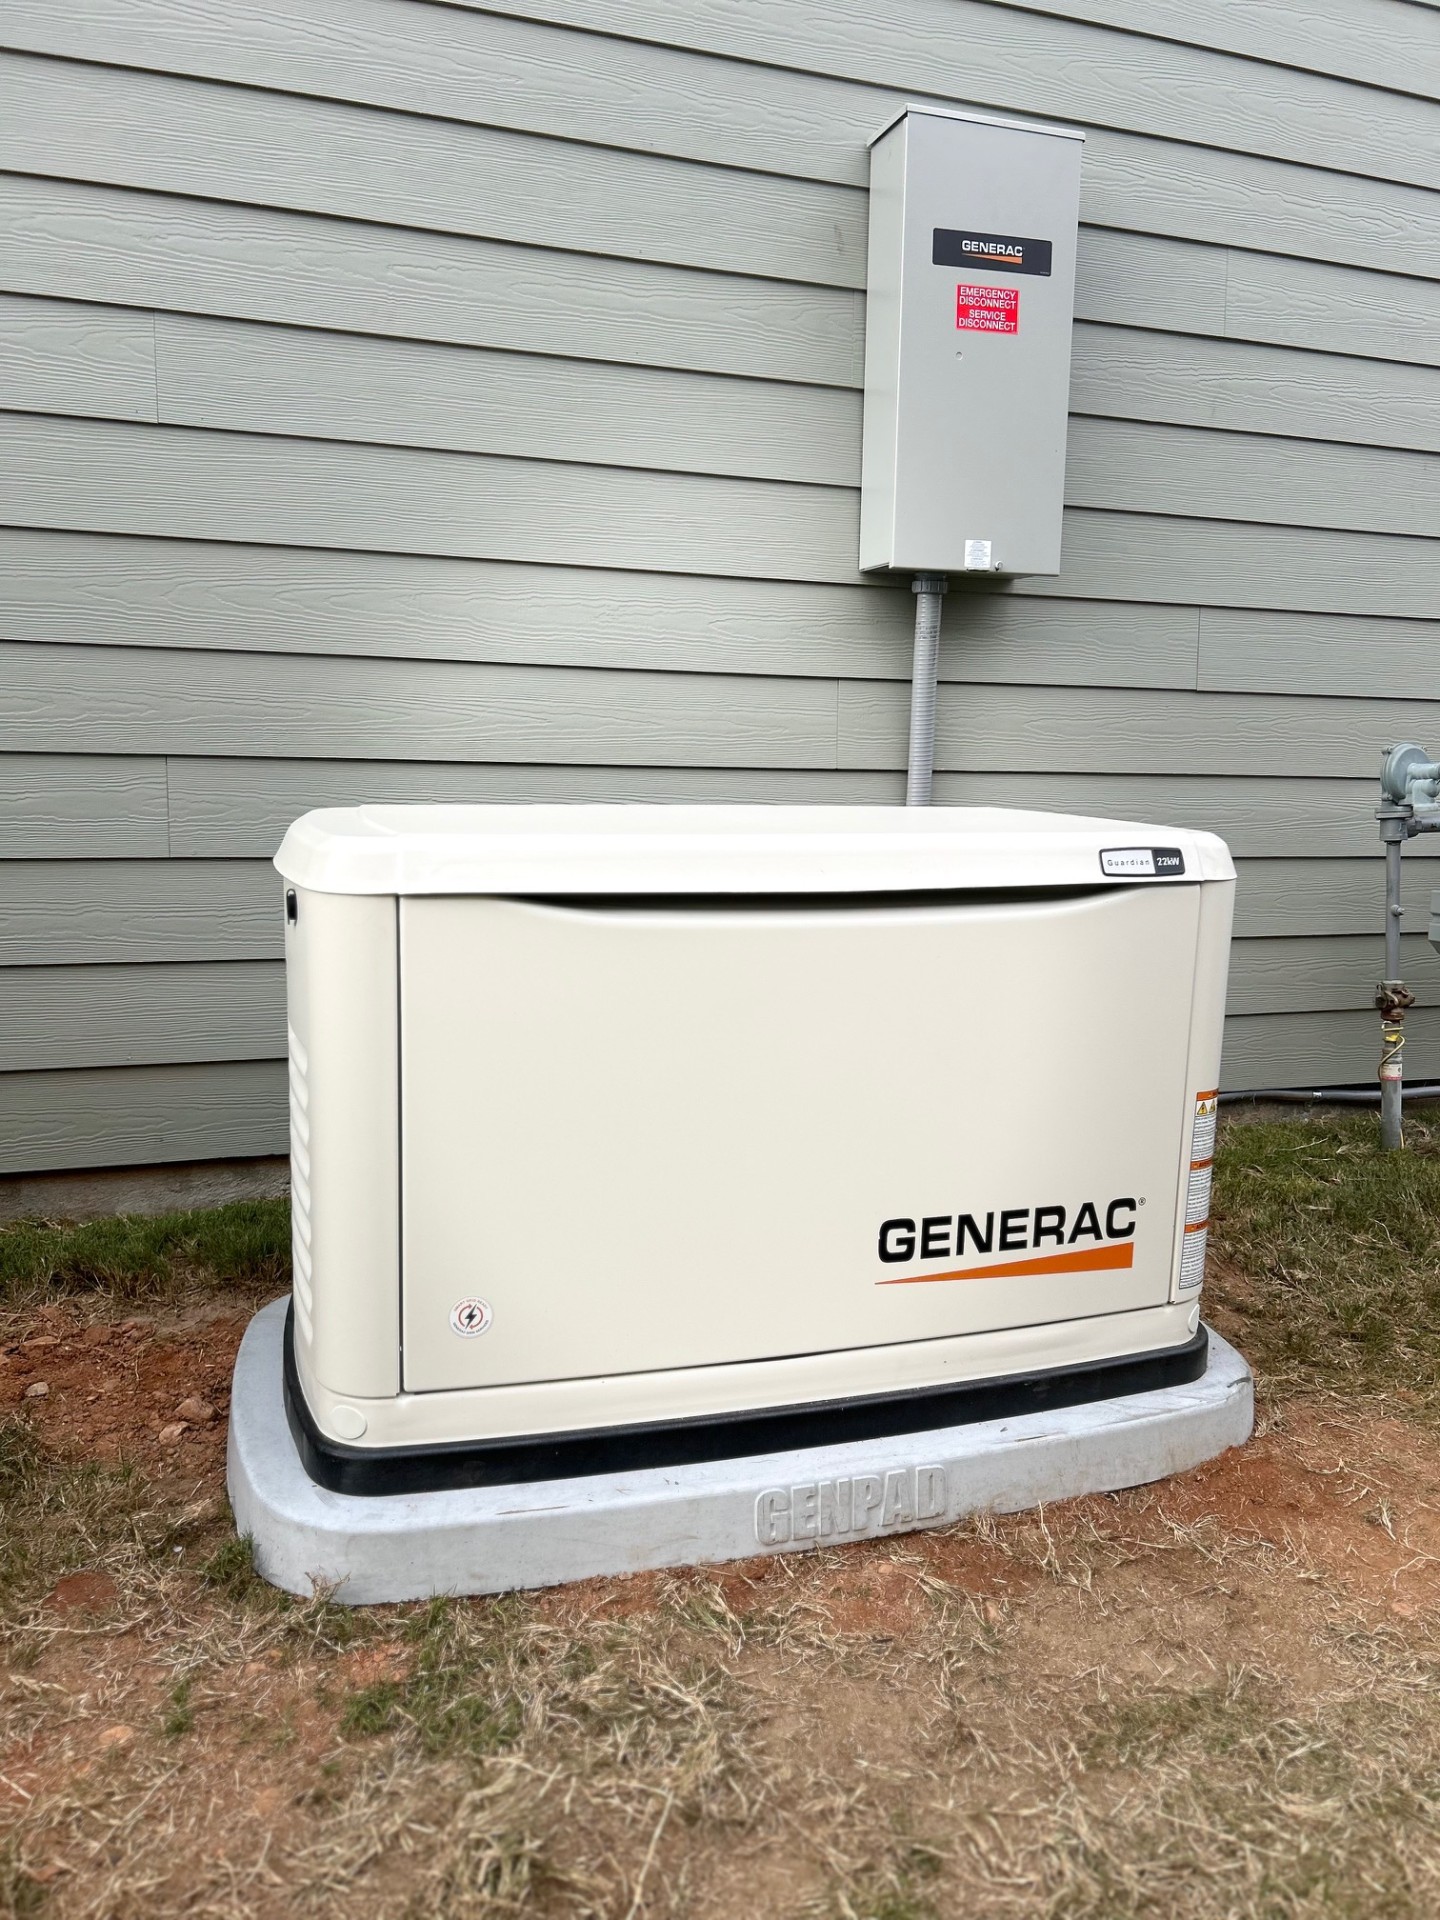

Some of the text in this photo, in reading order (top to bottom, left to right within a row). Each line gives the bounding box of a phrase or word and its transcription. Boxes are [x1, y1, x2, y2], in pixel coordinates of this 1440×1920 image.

[962, 240, 1023, 256] GENERAC
[960, 287, 1016, 300] EMERGENCY
[959, 296, 1016, 310] DISCONNECT
[969, 309, 1006, 321] SERVICE
[958, 318, 1016, 331] DISCONNECT
[1107, 859, 1150, 867] Guardian
[1157, 857, 1180, 866] 22kW
[878, 1197, 1137, 1263] GENERAC
[754, 1464, 948, 1545] GENPAD
